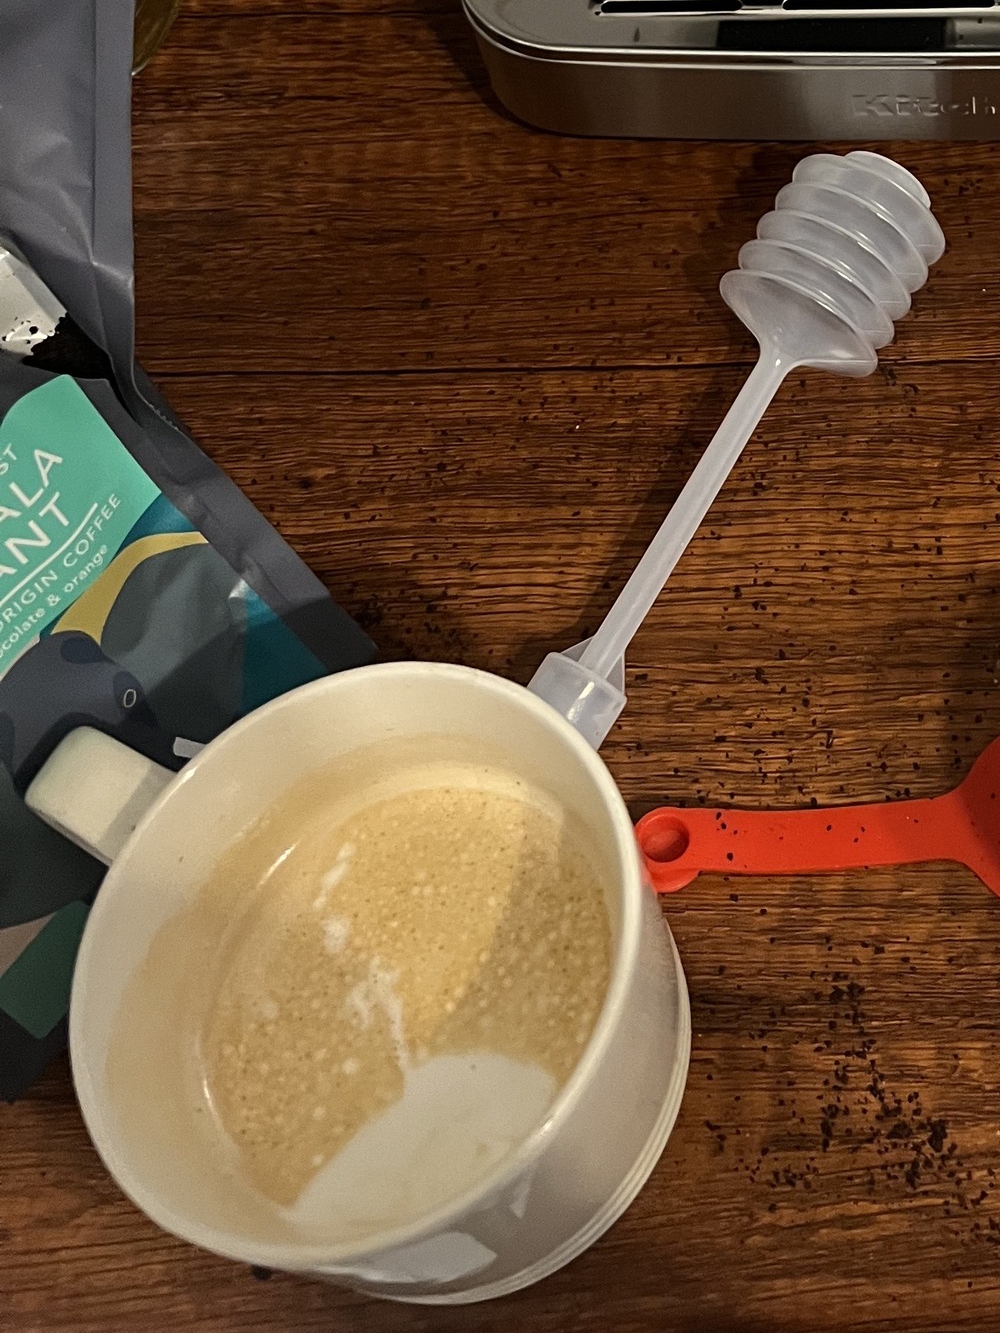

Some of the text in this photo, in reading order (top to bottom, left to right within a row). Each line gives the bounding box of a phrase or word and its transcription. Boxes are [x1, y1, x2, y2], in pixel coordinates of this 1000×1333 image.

[63, 493, 120, 567] COFFEE
[47, 594, 61, 606] &
[63, 544, 108, 593] orange
